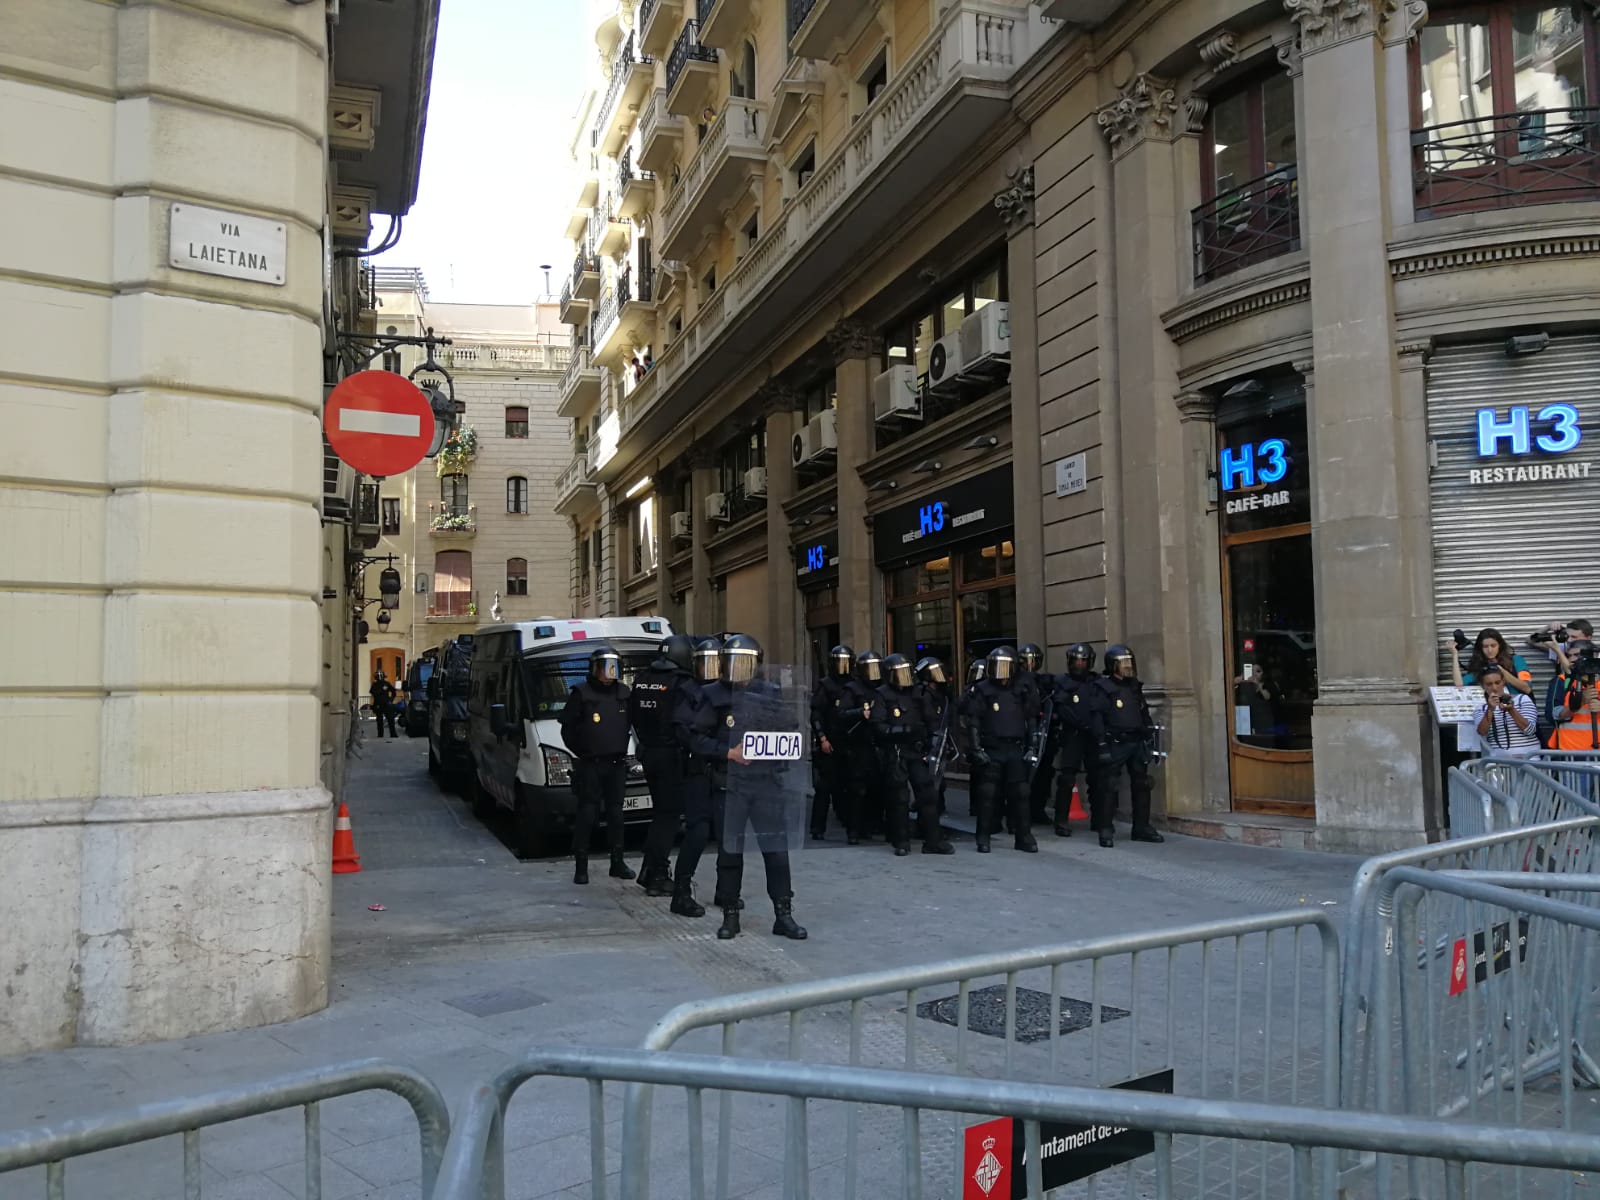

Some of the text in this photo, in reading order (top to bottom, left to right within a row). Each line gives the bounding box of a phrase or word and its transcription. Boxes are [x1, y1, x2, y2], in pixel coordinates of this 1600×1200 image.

[221, 222, 240, 237] VIA
[189, 242, 268, 271] LAIETANA
[1476, 402, 1582, 456] H3
[1220, 437, 1287, 490] H3
[1470, 462, 1592, 484] RESTAURANT
[920, 501, 944, 536] H3
[808, 544, 824, 572] H3
